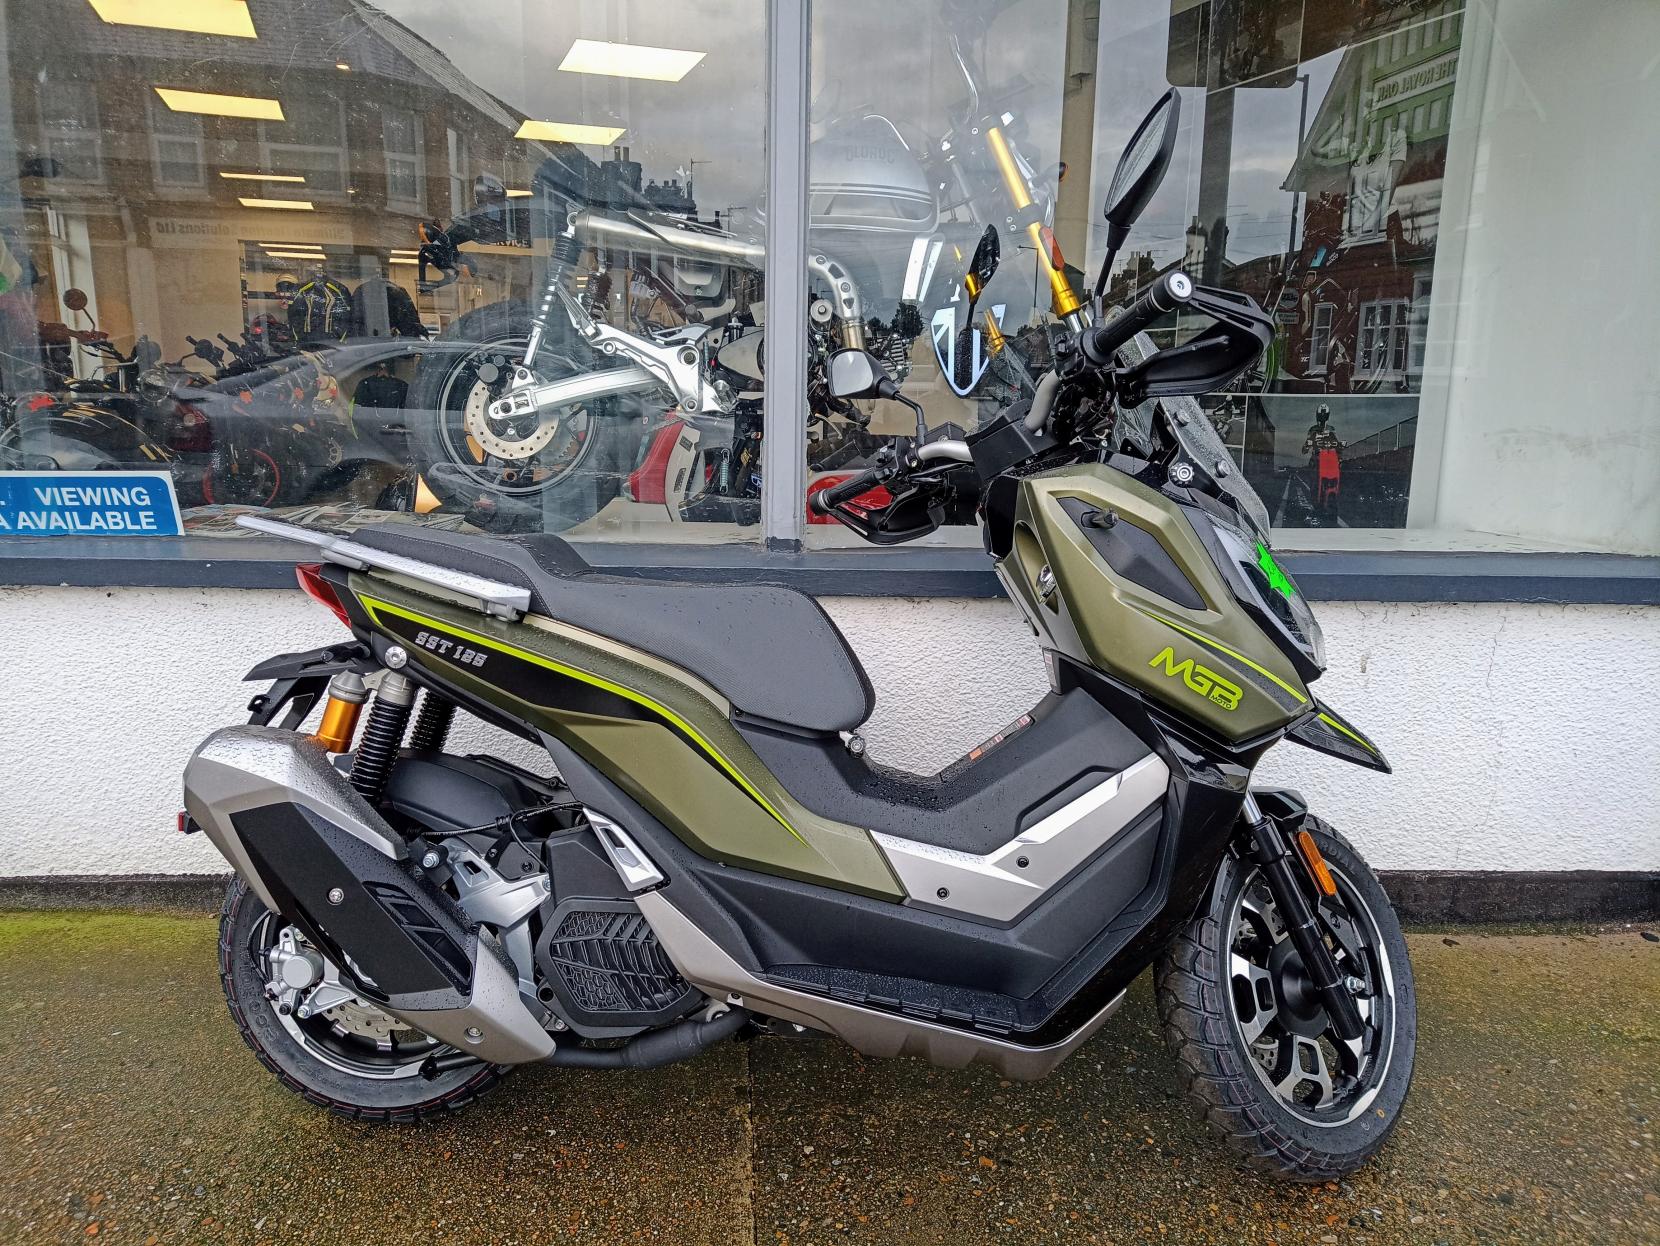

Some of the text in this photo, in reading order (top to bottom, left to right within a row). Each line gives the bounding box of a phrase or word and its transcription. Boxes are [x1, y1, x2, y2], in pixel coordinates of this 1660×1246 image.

[33, 487, 151, 506] VIEWING
[17, 511, 157, 530] AVAILABLE
[414, 631, 488, 667] SST 125
[1148, 647, 1243, 711] MGB
[1209, 694, 1232, 709] MOTO
